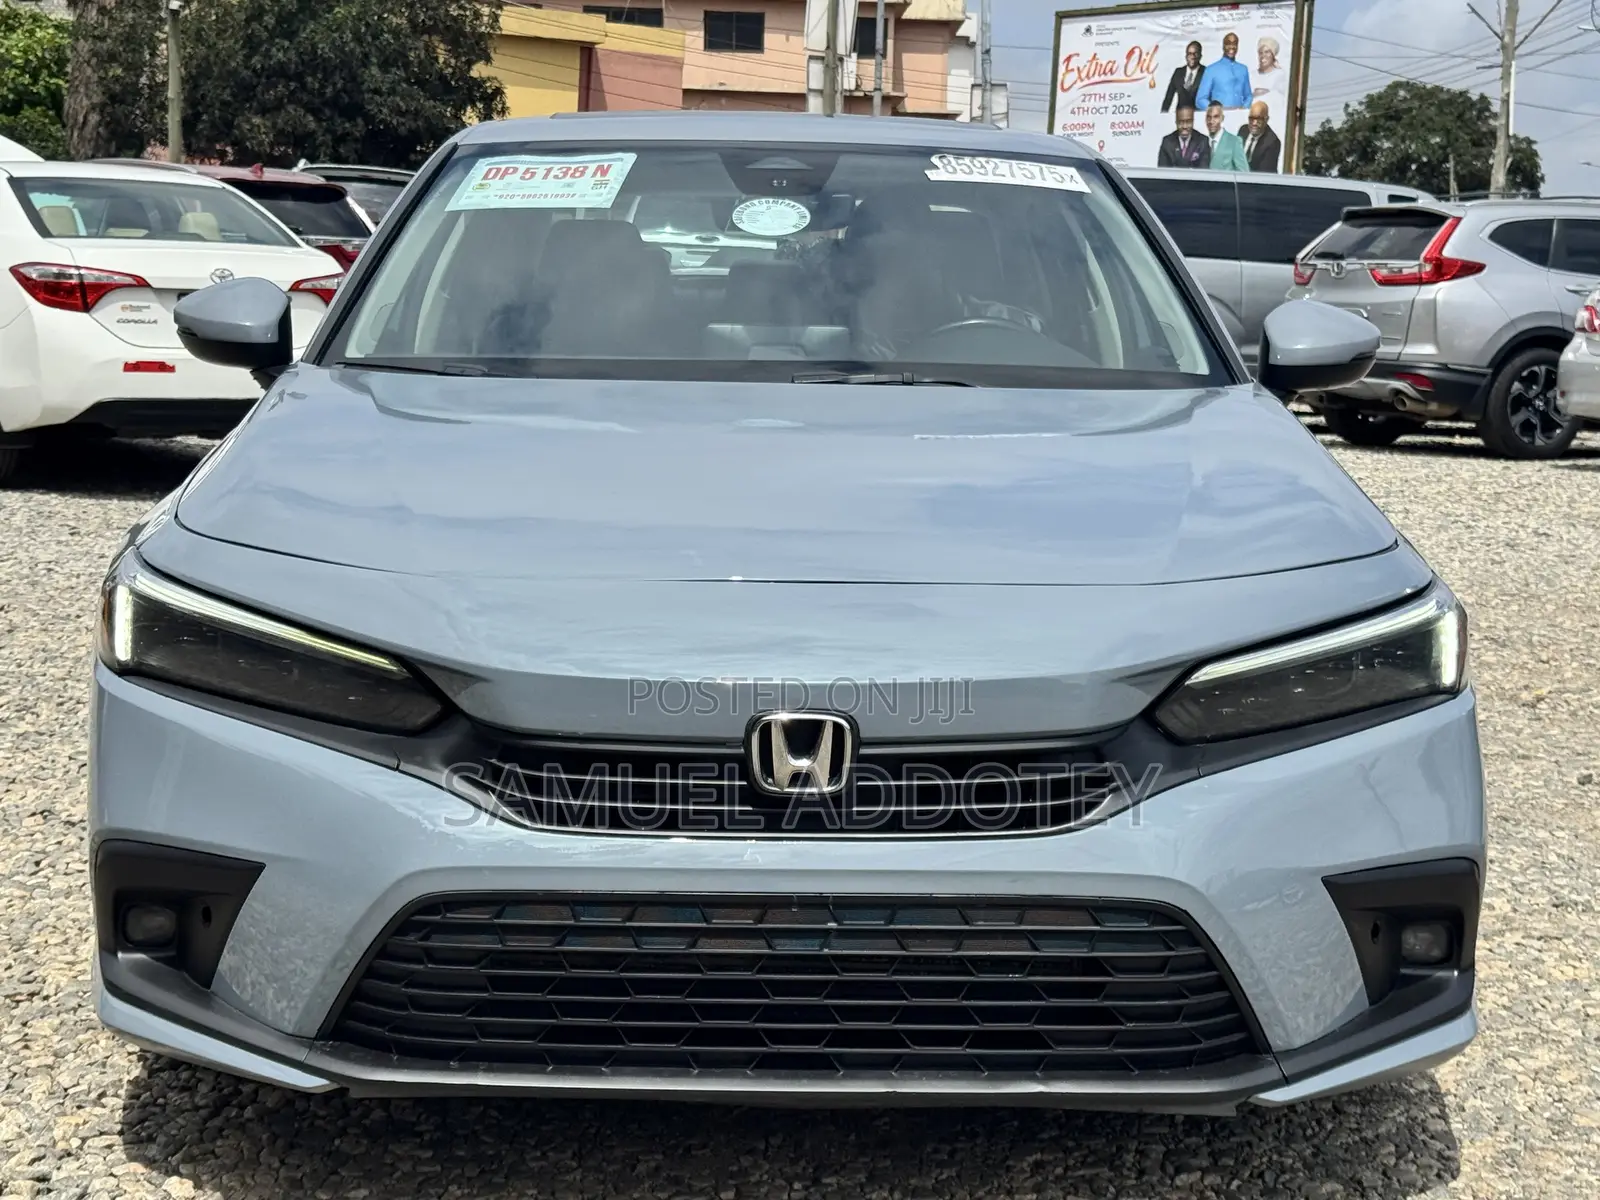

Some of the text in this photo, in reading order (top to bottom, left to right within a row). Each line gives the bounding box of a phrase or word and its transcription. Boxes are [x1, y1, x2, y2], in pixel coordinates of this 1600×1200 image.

[1060, 52, 1119, 92] Extra
[1081, 93, 1106, 103] 27TH
[1108, 92, 1125, 101] SEP
[1070, 104, 1138, 116] 4TH OCT 2026
[1062, 120, 1144, 132] 6:00PM 8:00AM
[481, 163, 613, 181] DP 5138 N
